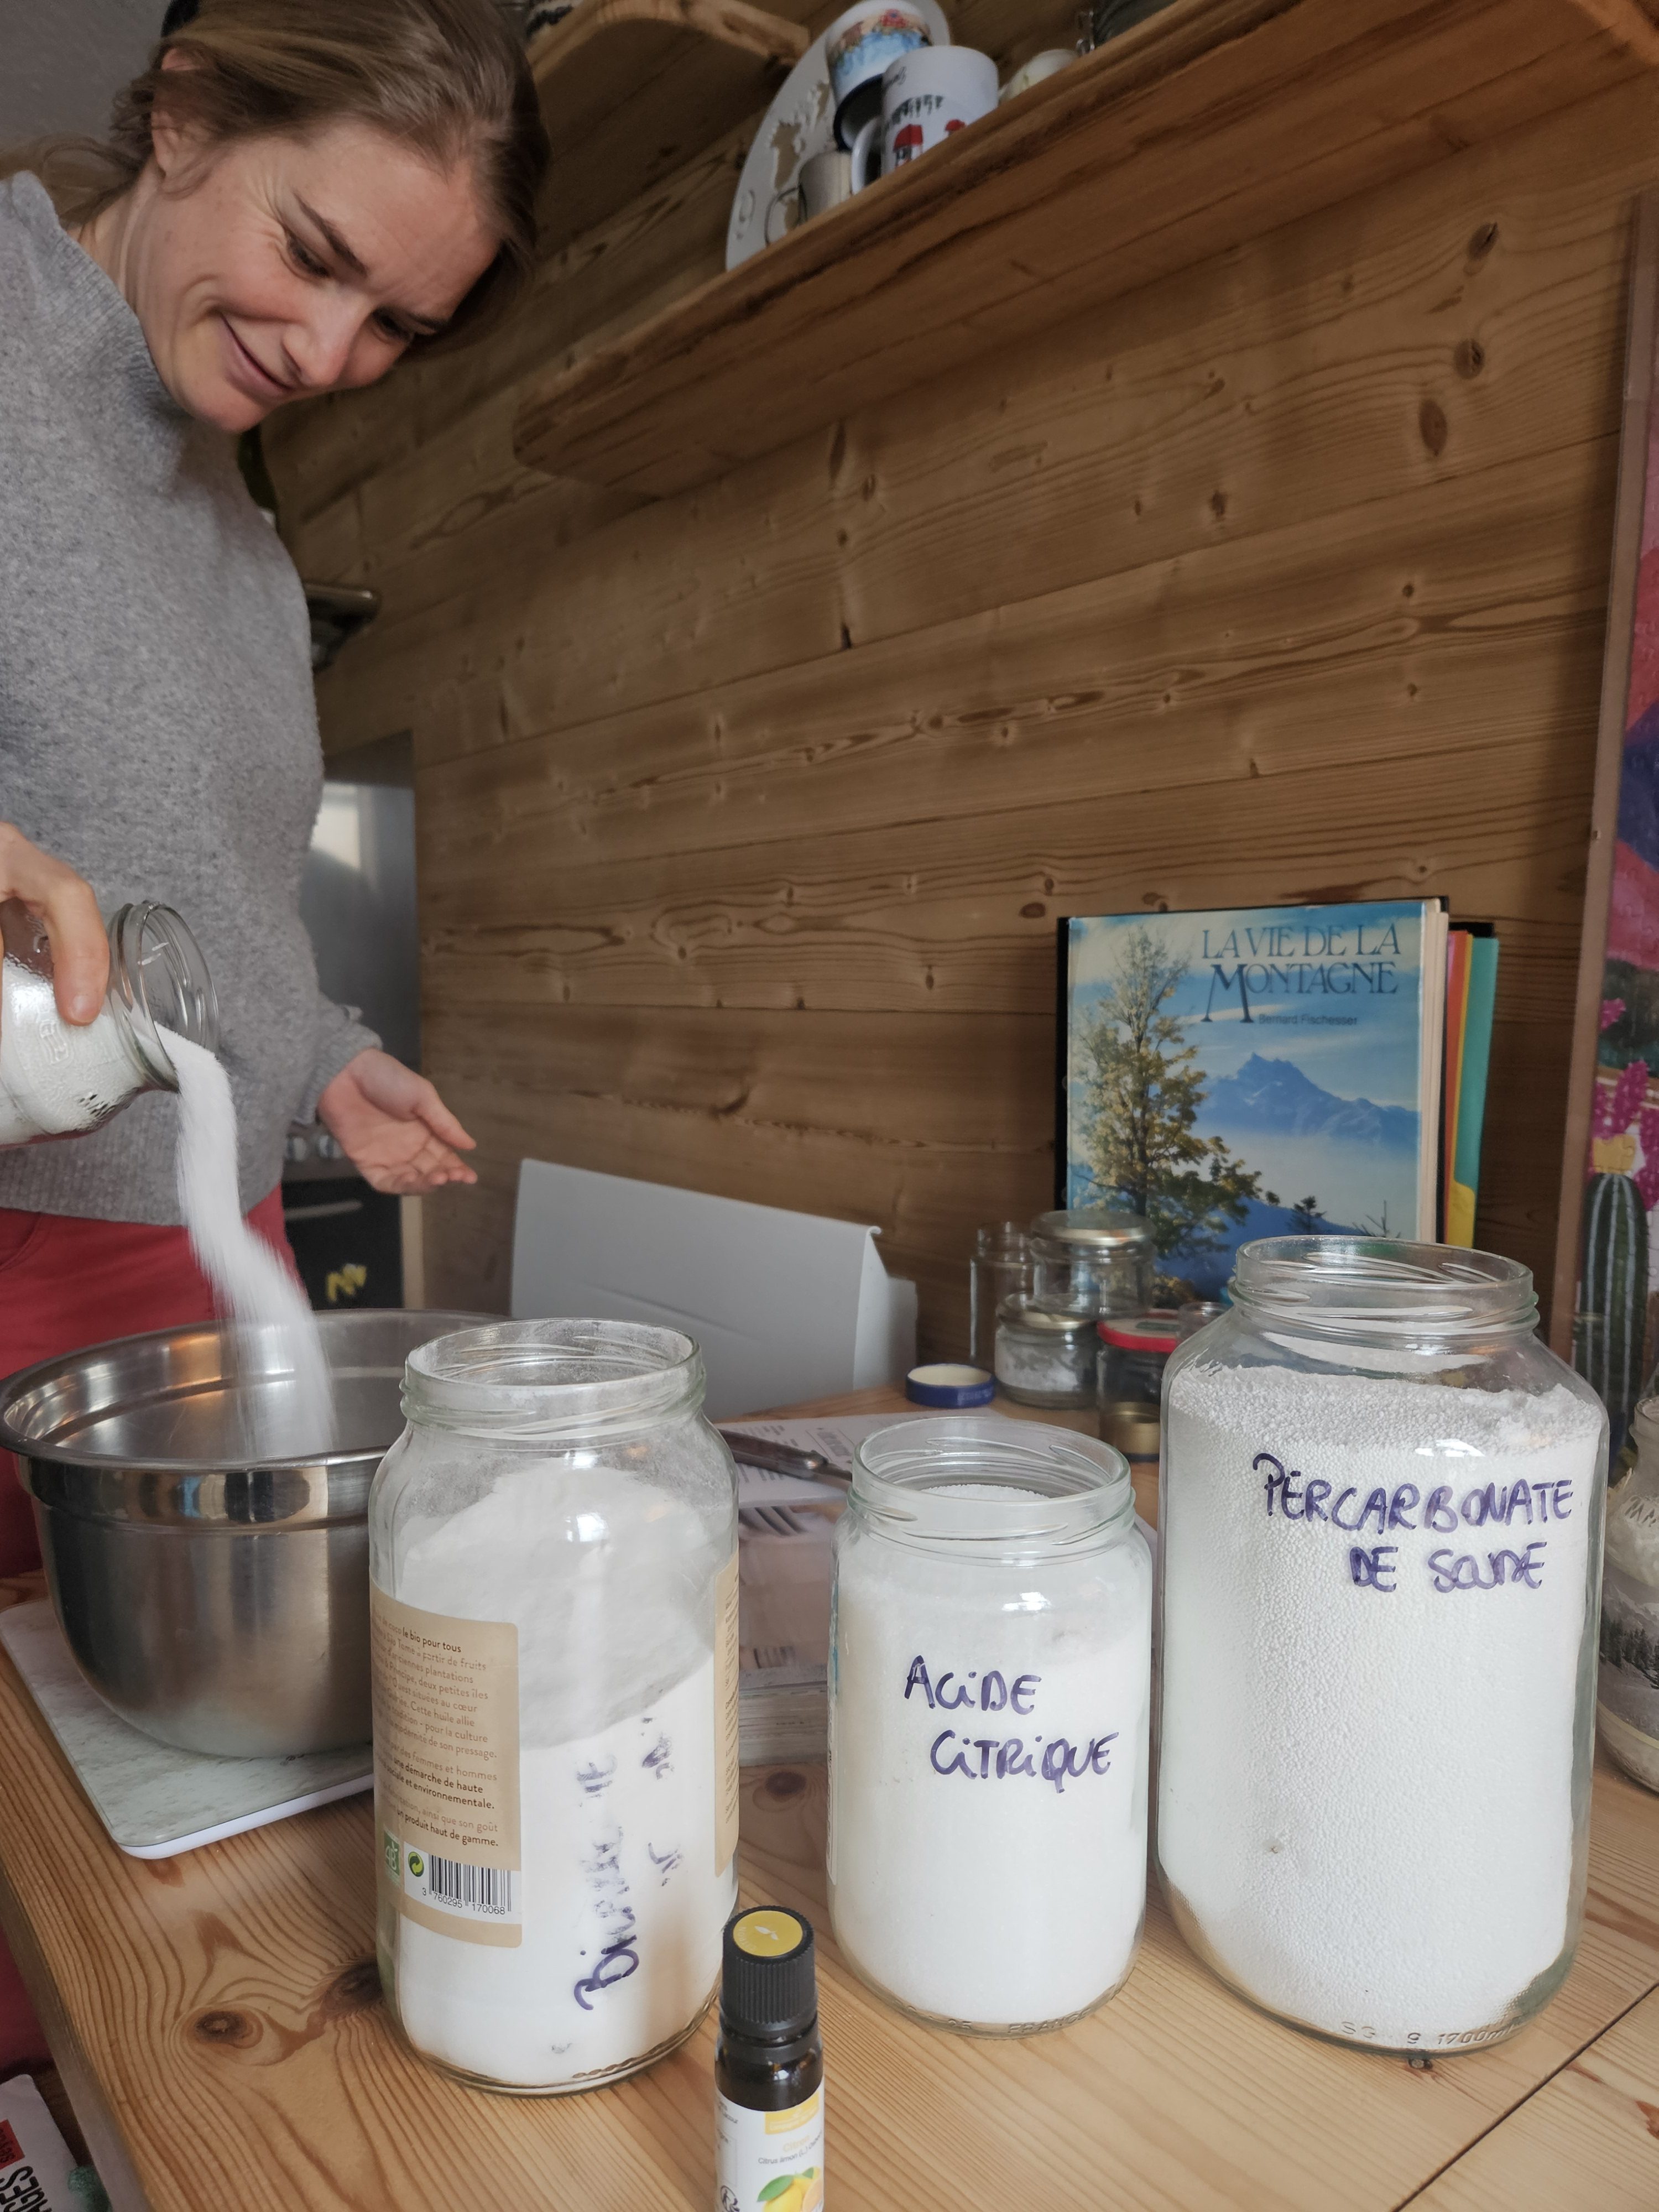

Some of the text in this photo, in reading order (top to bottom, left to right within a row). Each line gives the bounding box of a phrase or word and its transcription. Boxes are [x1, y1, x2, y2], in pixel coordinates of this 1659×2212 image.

[1202, 922, 1401, 959] LA VIE DE LA
[1200, 961, 1399, 1023] MONTAGNE
[1259, 1013, 1358, 1026] Bernard Fischesser
[1349, 1546, 1399, 1593] DE
[403, 1627, 409, 1638] le
[410, 1630, 421, 1642] bio
[422, 1638, 441, 1648] pour
[443, 1642, 462, 1653] tous
[397, 1638, 415, 1654] Tomé
[422, 1652, 445, 1663] partir
[447, 1656, 457, 1667] de
[461, 1658, 486, 1671] fruits
[419, 1676, 437, 1691] deux
[439, 1685, 469, 1697] petites
[425, 1666, 473, 1684] plantations
[410, 1700, 431, 1717] Cette
[434, 1709, 454, 1723] huile
[456, 1715, 475, 1726] allie
[441, 1700, 451, 1708] au
[453, 1704, 478, 1713] cœur
[425, 1724, 444, 1734] pour
[446, 1726, 452, 1737] la
[455, 1730, 488, 1743] culture
[429, 1736, 439, 1747] de
[440, 1743, 453, 1752] son
[456, 1746, 497, 1761] pressage.
[400, 1747, 411, 1759] des
[413, 1751, 443, 1771] femmes
[445, 1765, 453, 1773] et
[456, 1765, 497, 1781] hommes
[405, 1761, 442, 1785] démarche
[444, 1777, 454, 1788] de
[457, 1780, 483, 1793] haute
[405, 1778, 413, 1788] et
[414, 1783, 495, 1809] environnementale.
[405, 1813, 429, 1831] produit
[431, 1822, 447, 1837] haut
[450, 1829, 460, 1840] de
[462, 1834, 499, 1846] gamme.
[422, 1808, 440, 1820] ainsi
[442, 1815, 457, 1825] que
[459, 1820, 474, 1829] son
[477, 1822, 498, 1834] goût
[422, 1887, 505, 1915] 3 760295 170068
